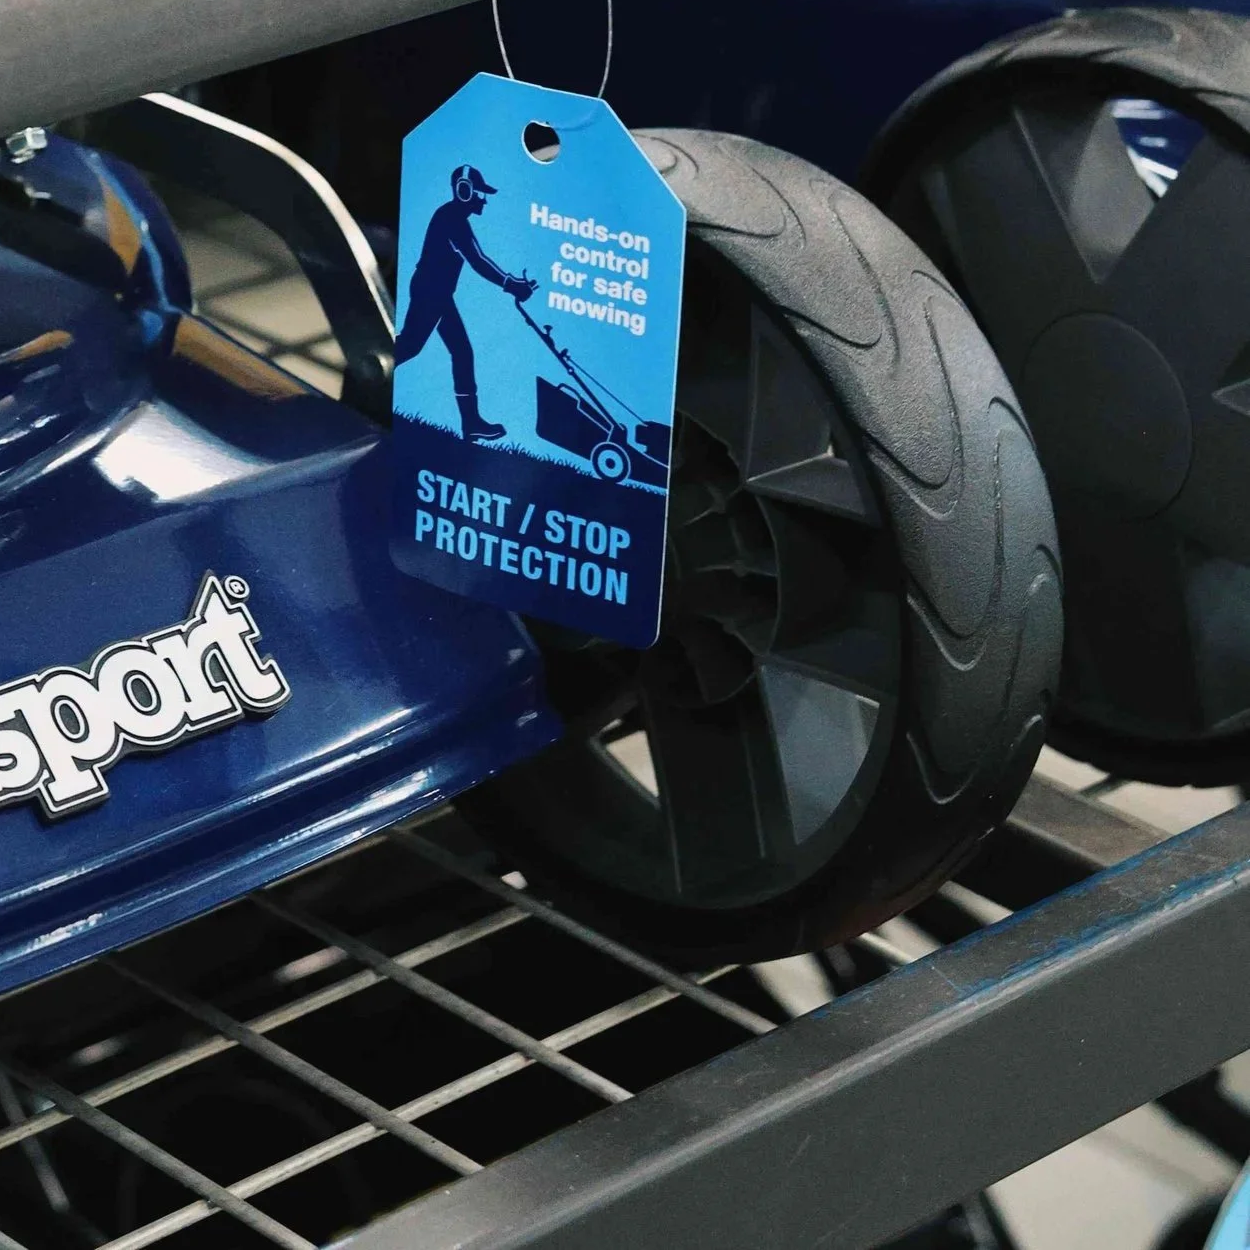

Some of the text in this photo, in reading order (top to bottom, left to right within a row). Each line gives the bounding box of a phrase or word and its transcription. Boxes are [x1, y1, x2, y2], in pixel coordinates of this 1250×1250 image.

[530, 202, 650, 254] Hands-on
[551, 261, 648, 306] for safe
[560, 242, 649, 280] control
[548, 291, 646, 336] mowing
[417, 469, 512, 528] START
[544, 510, 631, 559] STOP
[415, 509, 628, 605] PROTECTION
